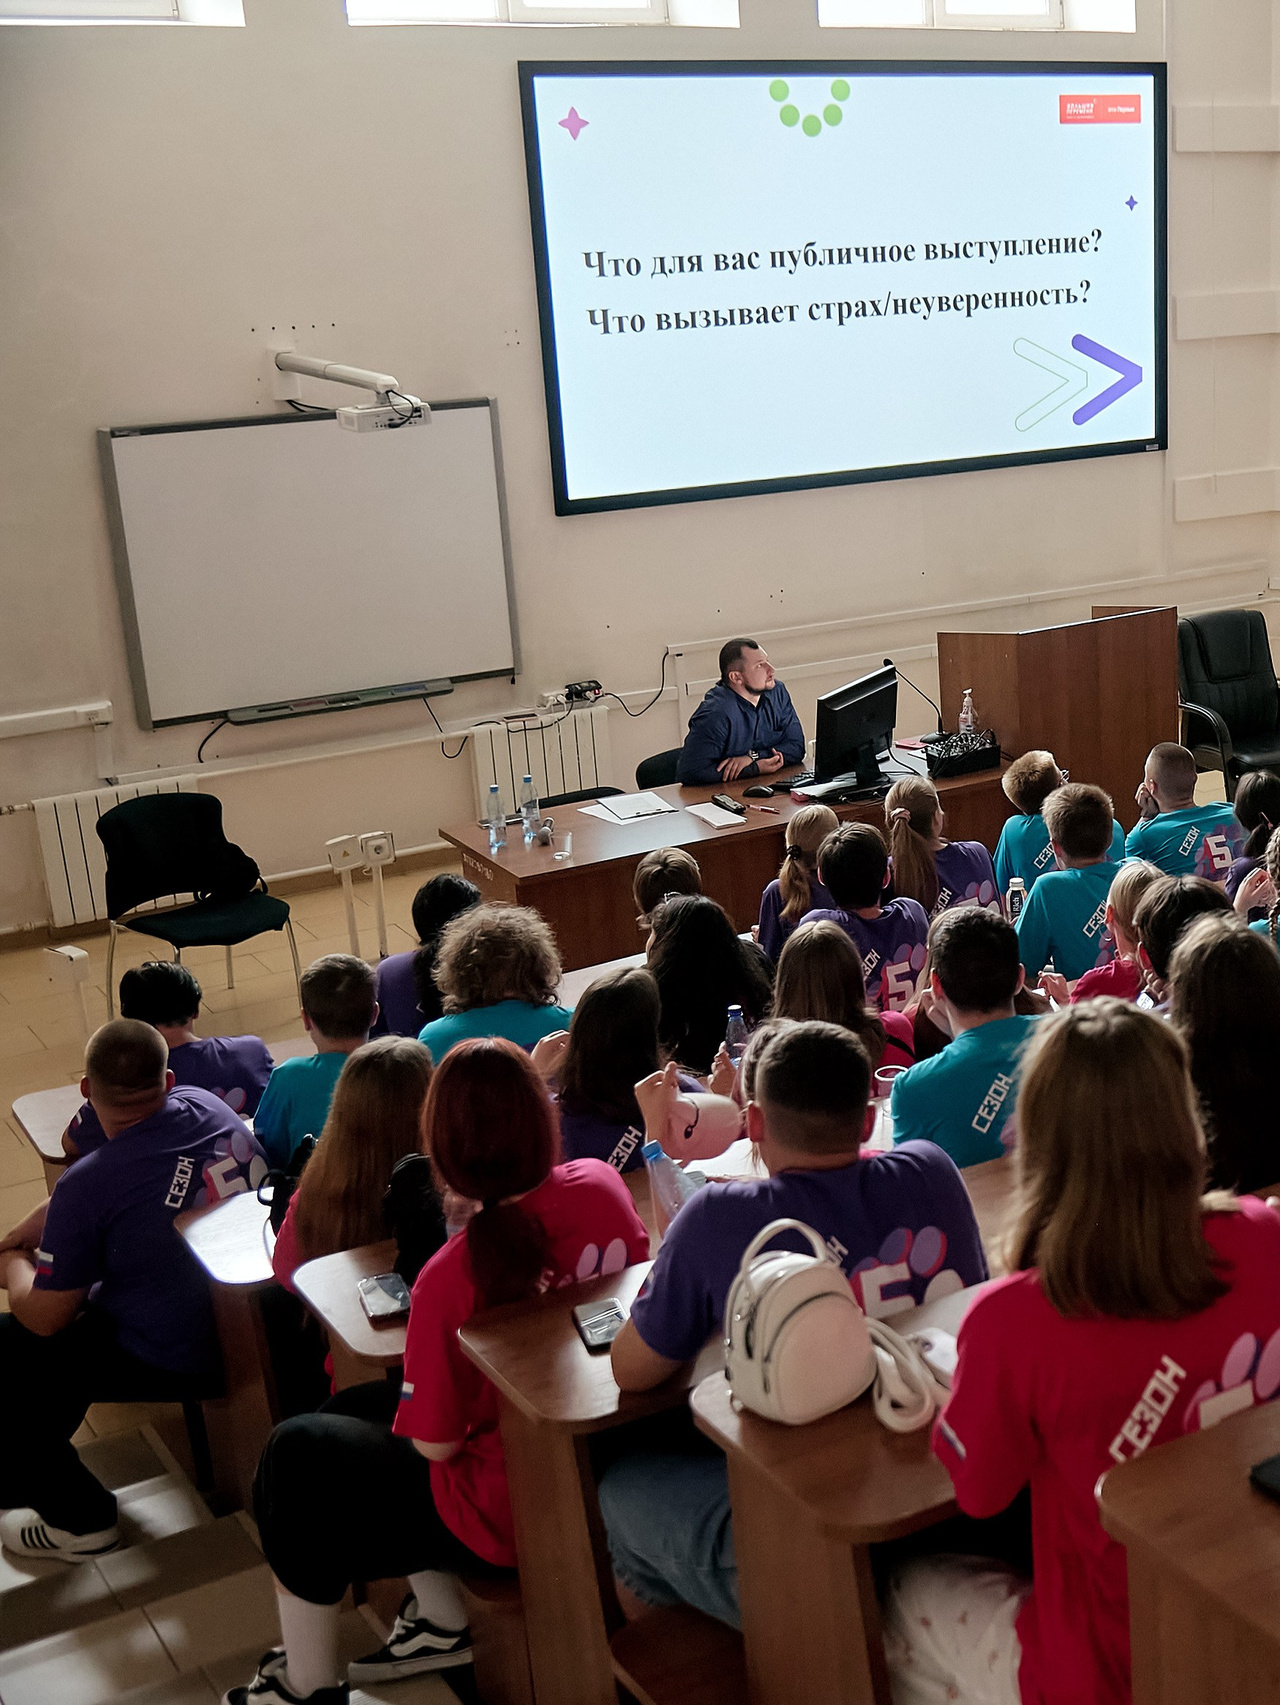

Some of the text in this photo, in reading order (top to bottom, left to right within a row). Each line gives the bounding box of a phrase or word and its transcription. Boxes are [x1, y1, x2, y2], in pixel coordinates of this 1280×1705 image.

[582, 228, 1102, 279] Что для вас публичное выступление?
[587, 279, 1092, 335] Что вызывает страх/неуверенность?
[1178, 825, 1201, 857] СЕЗОН
[1206, 834, 1234, 870] 5
[1012, 897, 1021, 912] Rich
[885, 961, 917, 1012] 5
[971, 1072, 1013, 1134] СЕЗОН
[164, 1155, 196, 1209] СЕЗОН
